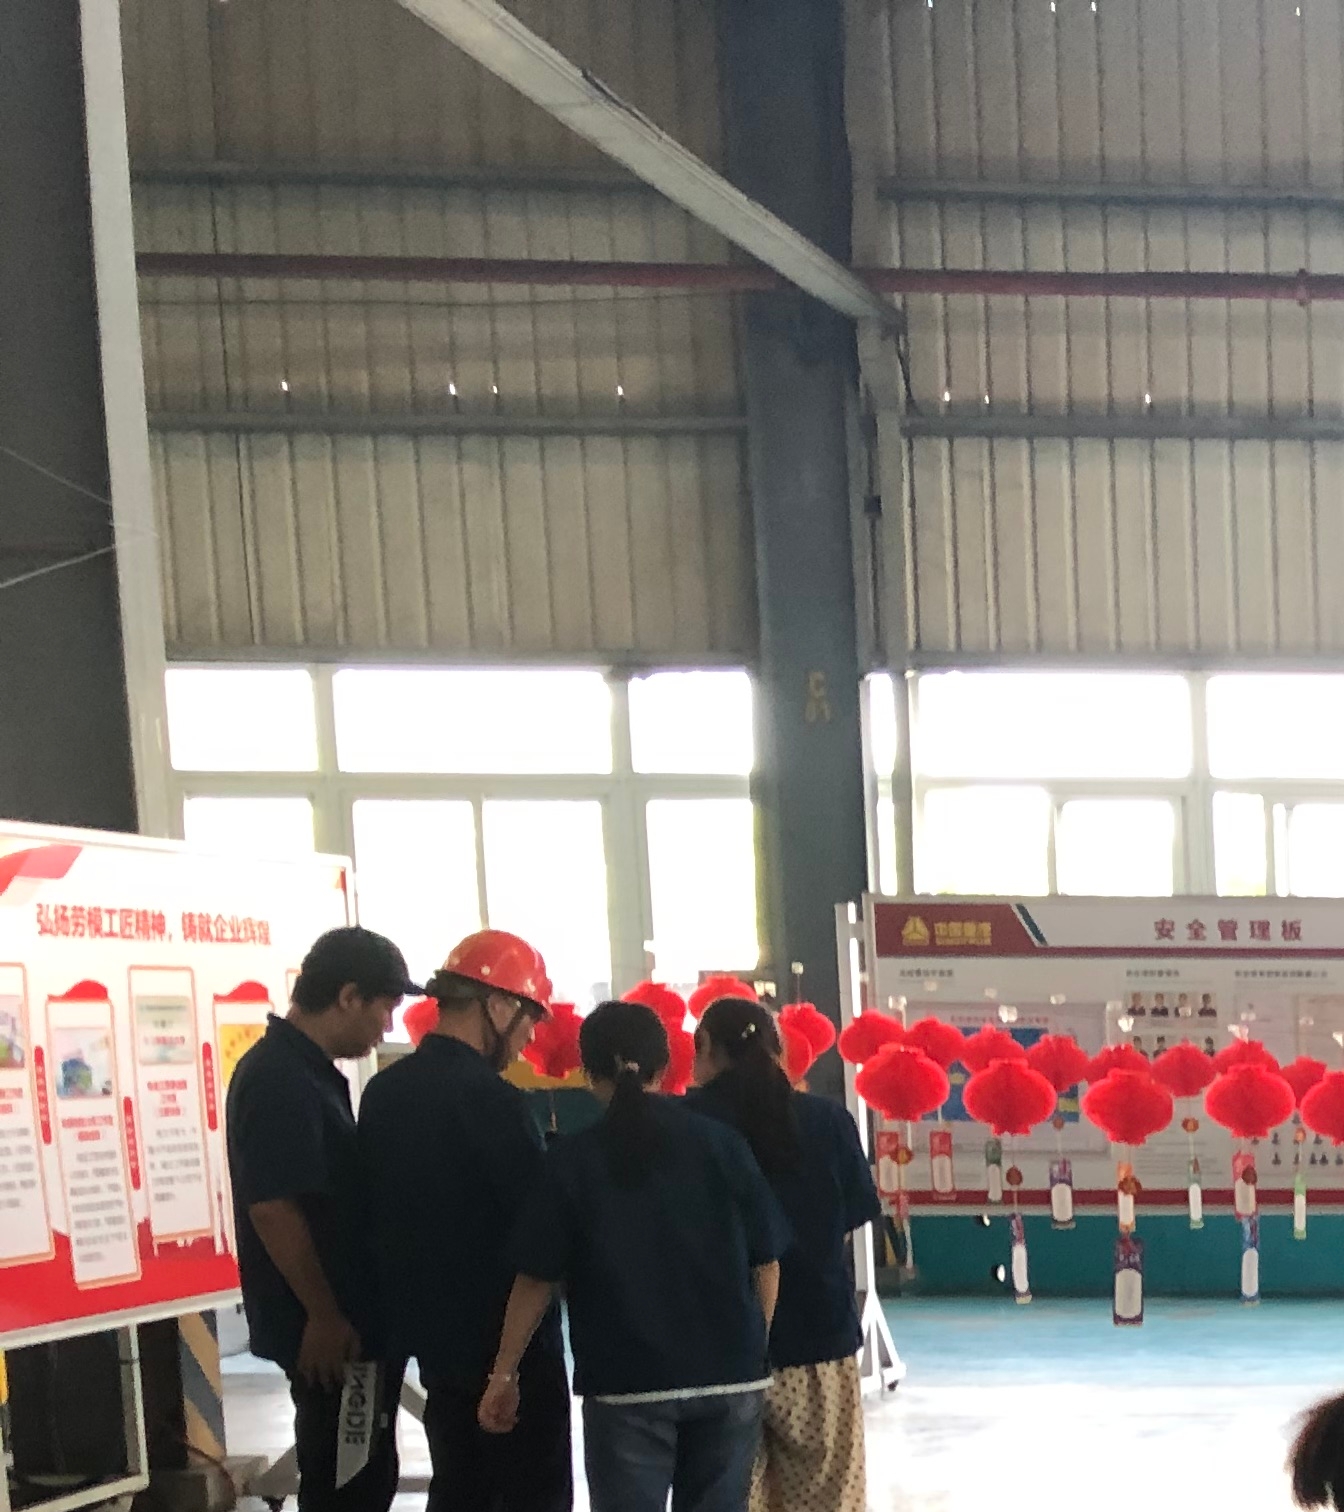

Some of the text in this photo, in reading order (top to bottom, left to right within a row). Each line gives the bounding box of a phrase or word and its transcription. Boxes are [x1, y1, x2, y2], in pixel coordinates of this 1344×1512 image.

[1154, 918, 1302, 941] 安全管理板
